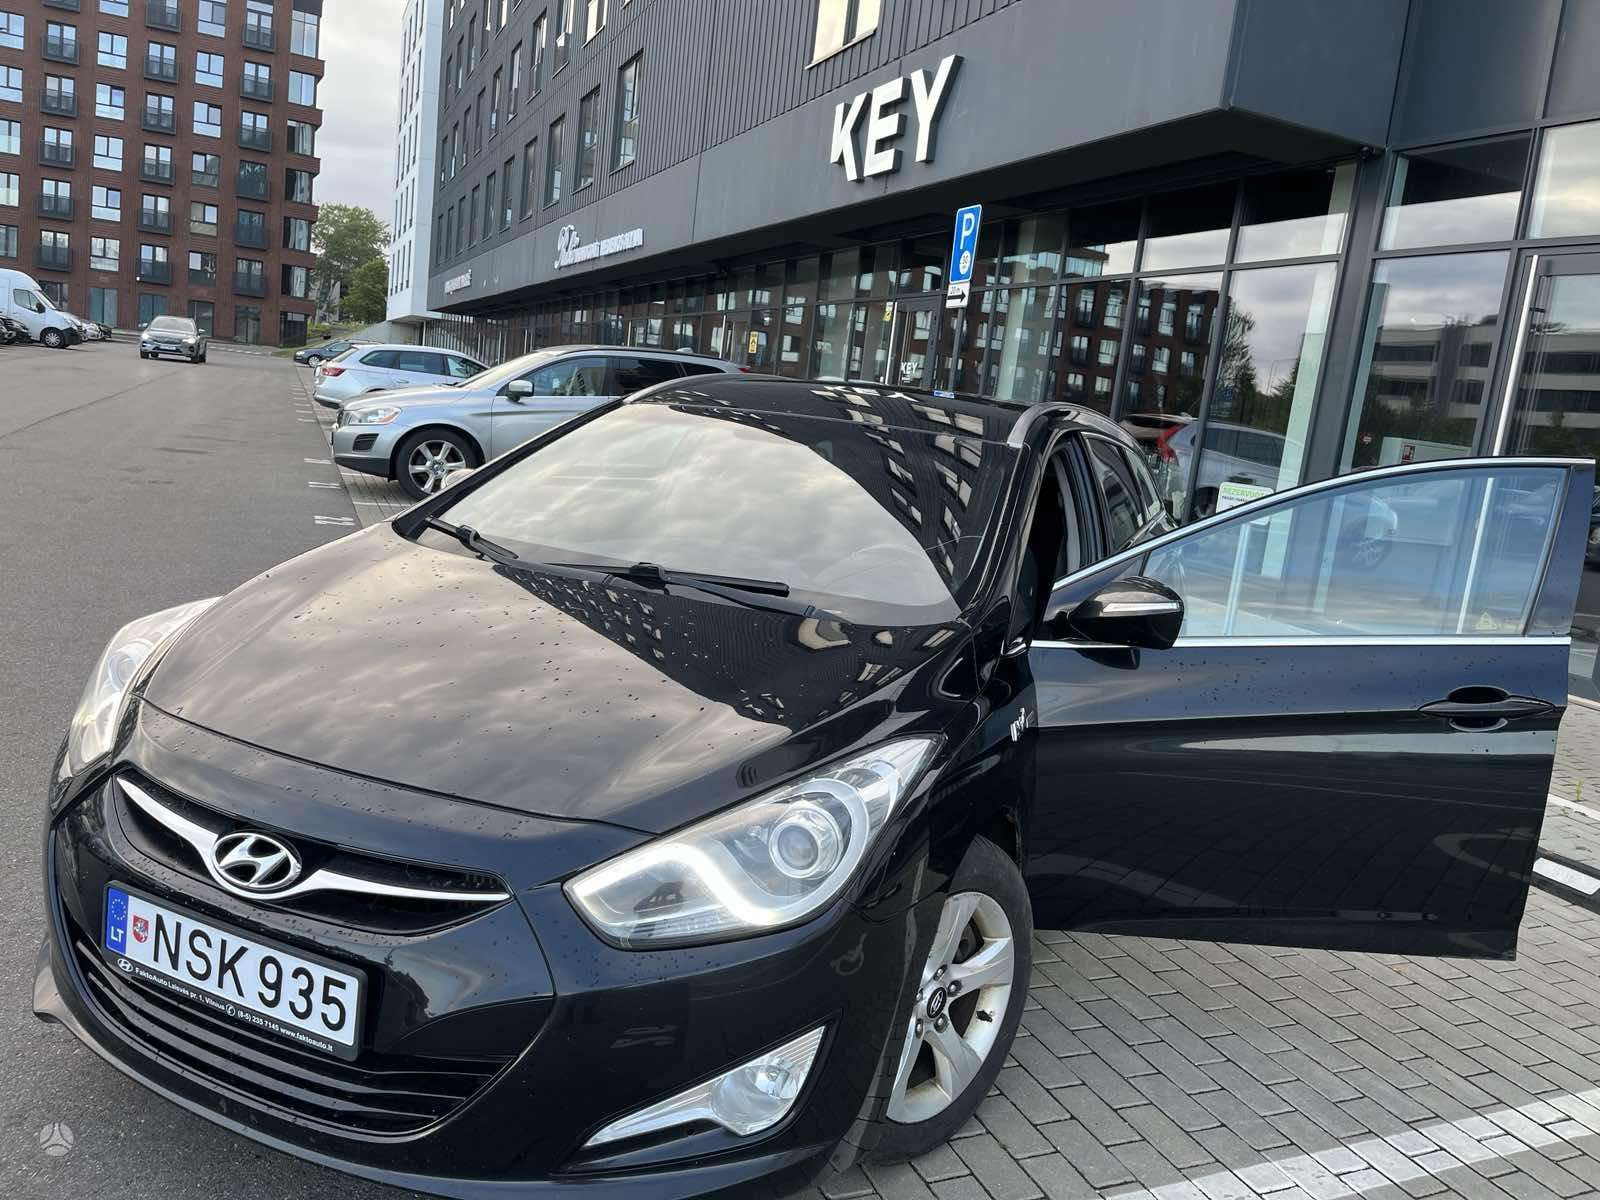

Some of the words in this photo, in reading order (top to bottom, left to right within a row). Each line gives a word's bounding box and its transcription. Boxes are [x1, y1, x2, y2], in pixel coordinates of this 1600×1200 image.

[830, 54, 962, 182] KEY
[960, 212, 975, 250] P
[901, 361, 917, 375] KEY
[110, 925, 124, 943] LT
[153, 912, 249, 998] NSK
[258, 955, 346, 1032] 935
[135, 967, 168, 986] FaktoAuto
[205, 996, 226, 1011] Vilnius
[279, 1027, 334, 1053] www.faktoauto.lt
